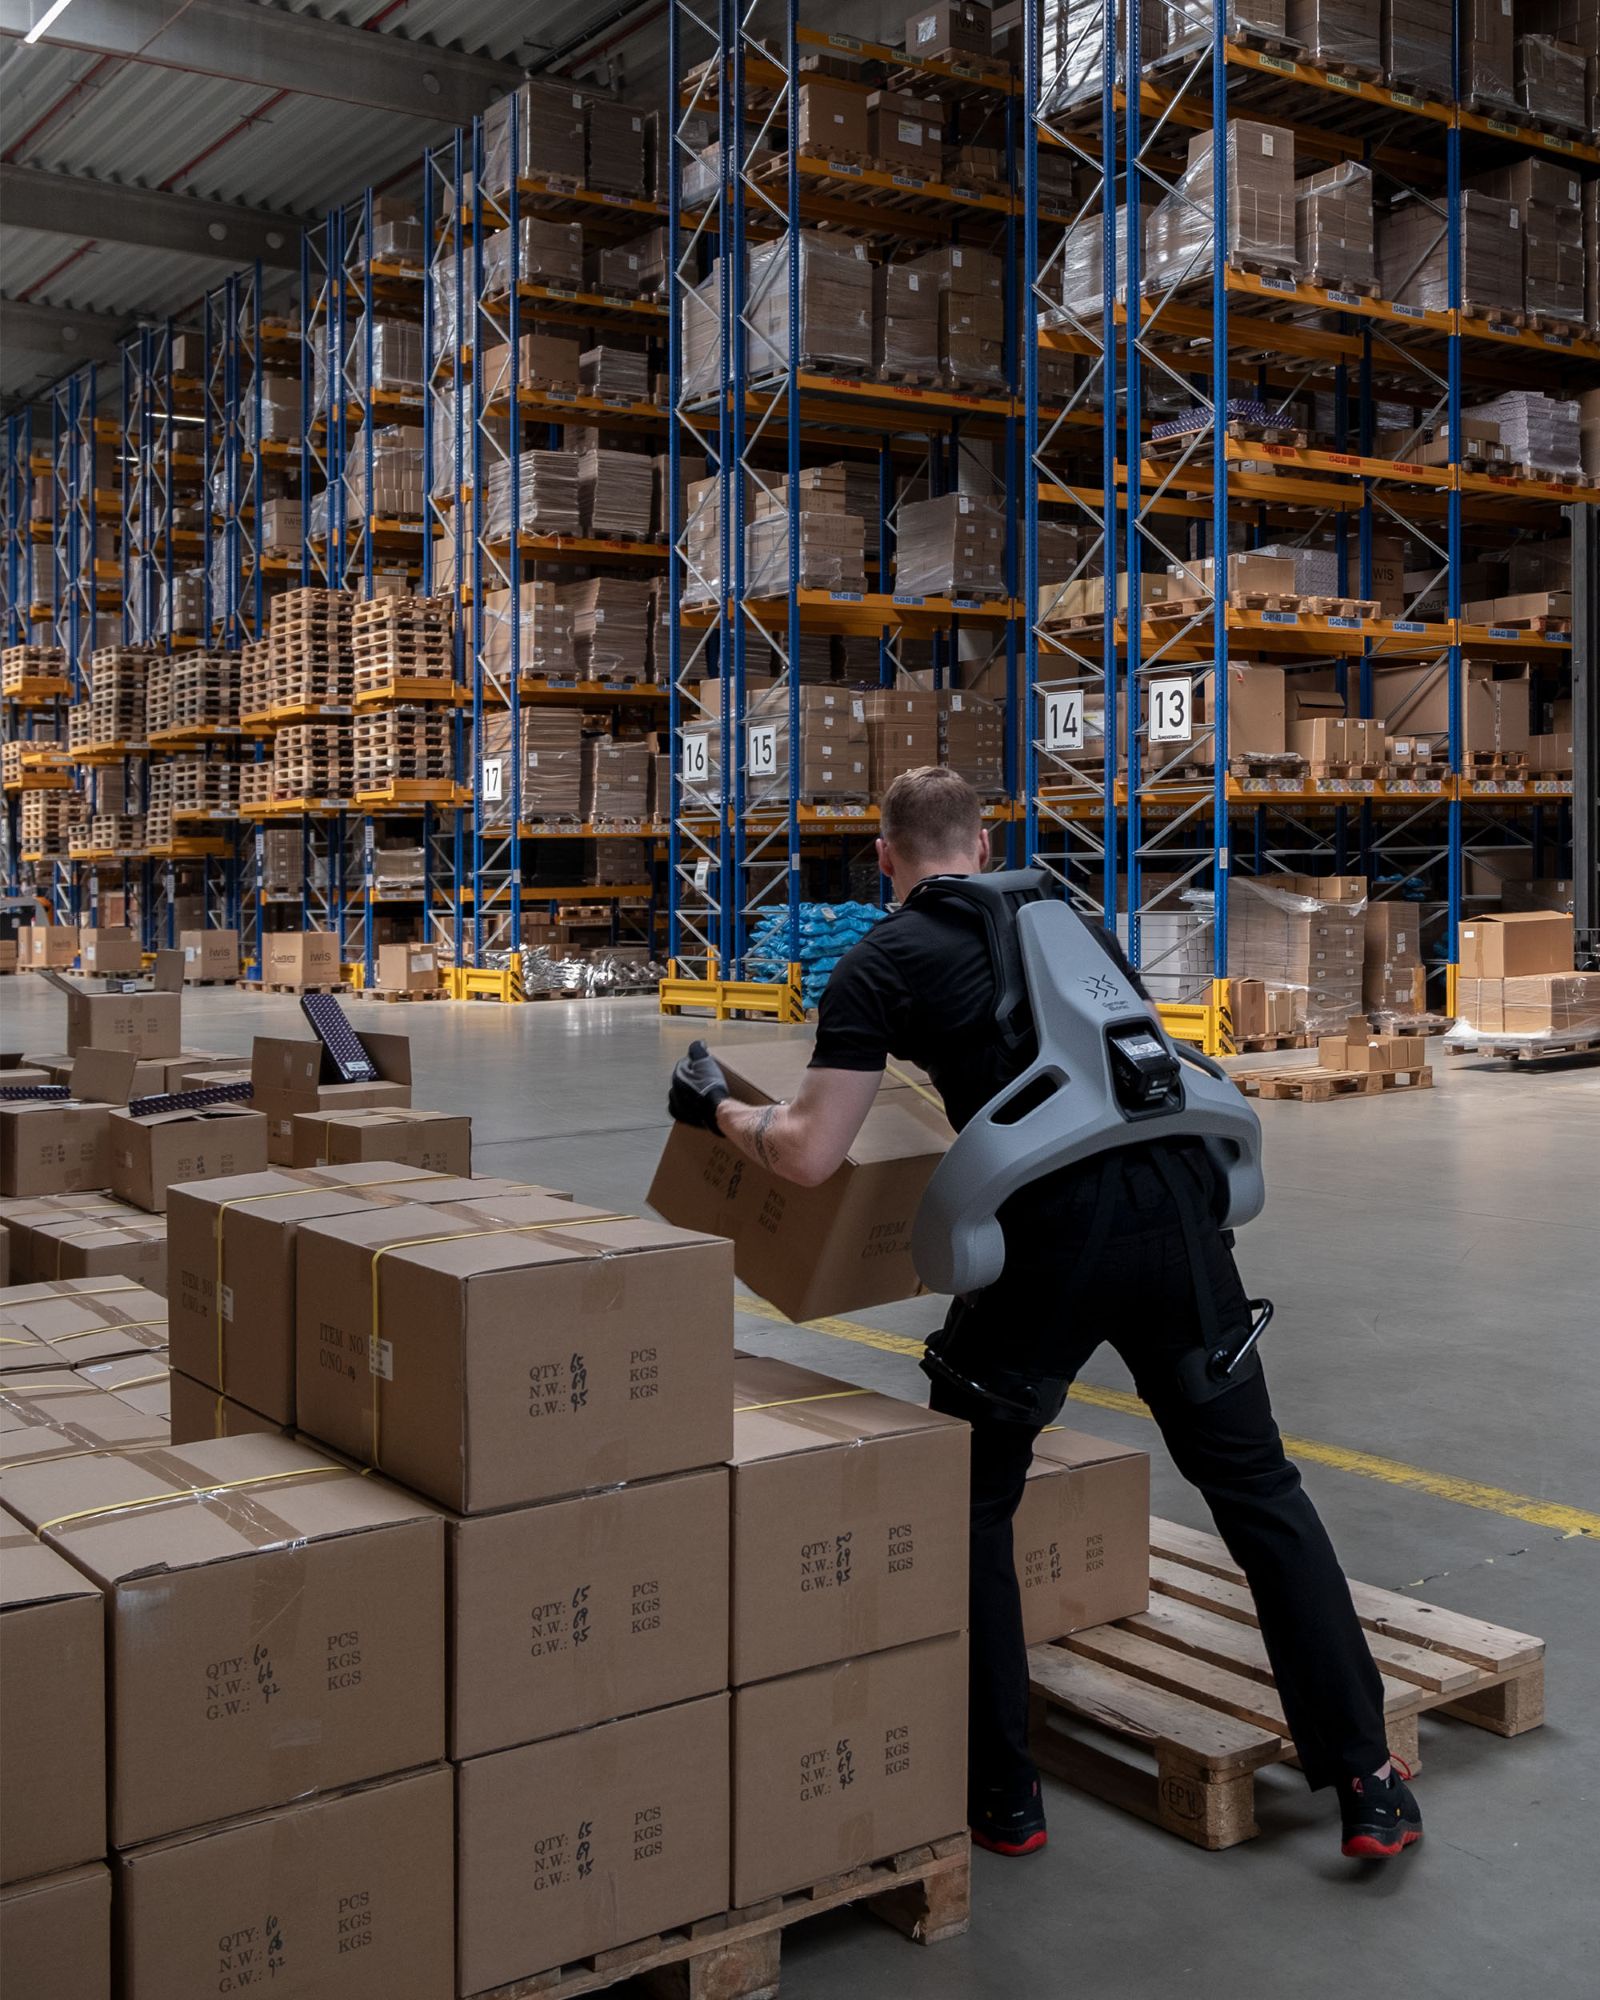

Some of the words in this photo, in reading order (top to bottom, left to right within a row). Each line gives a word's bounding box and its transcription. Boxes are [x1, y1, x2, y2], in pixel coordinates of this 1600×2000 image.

[1372, 565, 1394, 581] wis
[1050, 703, 1078, 739] 14
[1155, 690, 1184, 729] 13
[686, 743, 704, 772] 16
[753, 735, 772, 766] 15
[486, 767, 498, 790] 17
[310, 951, 332, 962] iwis
[320, 1322, 343, 1348] ITEM
[529, 1363, 564, 1382] QTY:
[570, 1353, 584, 1373] 65
[630, 1348, 657, 1364] PCS
[529, 1383, 566, 1399] N.W.:
[630, 1366, 659, 1382] KGS
[529, 1401, 565, 1417] G.W.:
[630, 1384, 659, 1400] KGS
[801, 1541, 831, 1559] QTY:
[888, 1524, 912, 1540] PCS
[801, 1559, 833, 1575] N.W.:
[888, 1541, 914, 1557] KGS
[801, 1576, 832, 1593] G.W.:
[888, 1557, 914, 1573] KGS
[531, 1602, 566, 1622] QTY:
[572, 1585, 591, 1608] 65
[632, 1581, 659, 1598] PCS
[531, 1621, 568, 1639] N.W.:
[631, 1598, 660, 1616] KGS
[206, 1657, 248, 1681] QTY:
[254, 1644, 268, 1666] 60
[327, 1631, 359, 1651] PCS
[531, 1639, 567, 1657] G.W.:
[631, 1616, 660, 1634] KGS
[206, 1679, 250, 1701] N.W.:
[326, 1650, 362, 1671] KGS
[206, 1700, 250, 1720] G.W.:
[327, 1670, 362, 1691] KGS
[800, 1750, 830, 1768] QTY:
[836, 1739, 850, 1755] 65
[885, 1726, 908, 1743] PCS
[800, 1767, 832, 1785] N.W.:
[885, 1742, 909, 1760] KGS
[800, 1784, 831, 1801] G.W.:
[885, 1758, 909, 1776] KGS
[534, 1834, 568, 1856] QTY:
[578, 1821, 593, 1840] 65
[634, 1807, 661, 1825] PCS
[534, 1853, 571, 1873] N.W.:
[633, 1824, 663, 1843] KGS
[534, 1872, 570, 1891] G.W.:
[633, 1841, 663, 1861] KGS
[218, 1928, 260, 1953] QTY:
[266, 1915, 278, 1936] 60
[338, 1892, 370, 1913] PCS
[218, 1950, 262, 1973] N.W.:
[337, 1911, 372, 1934] KGS
[218, 1970, 262, 1993] G.W.:
[337, 1931, 373, 1954] KGS
